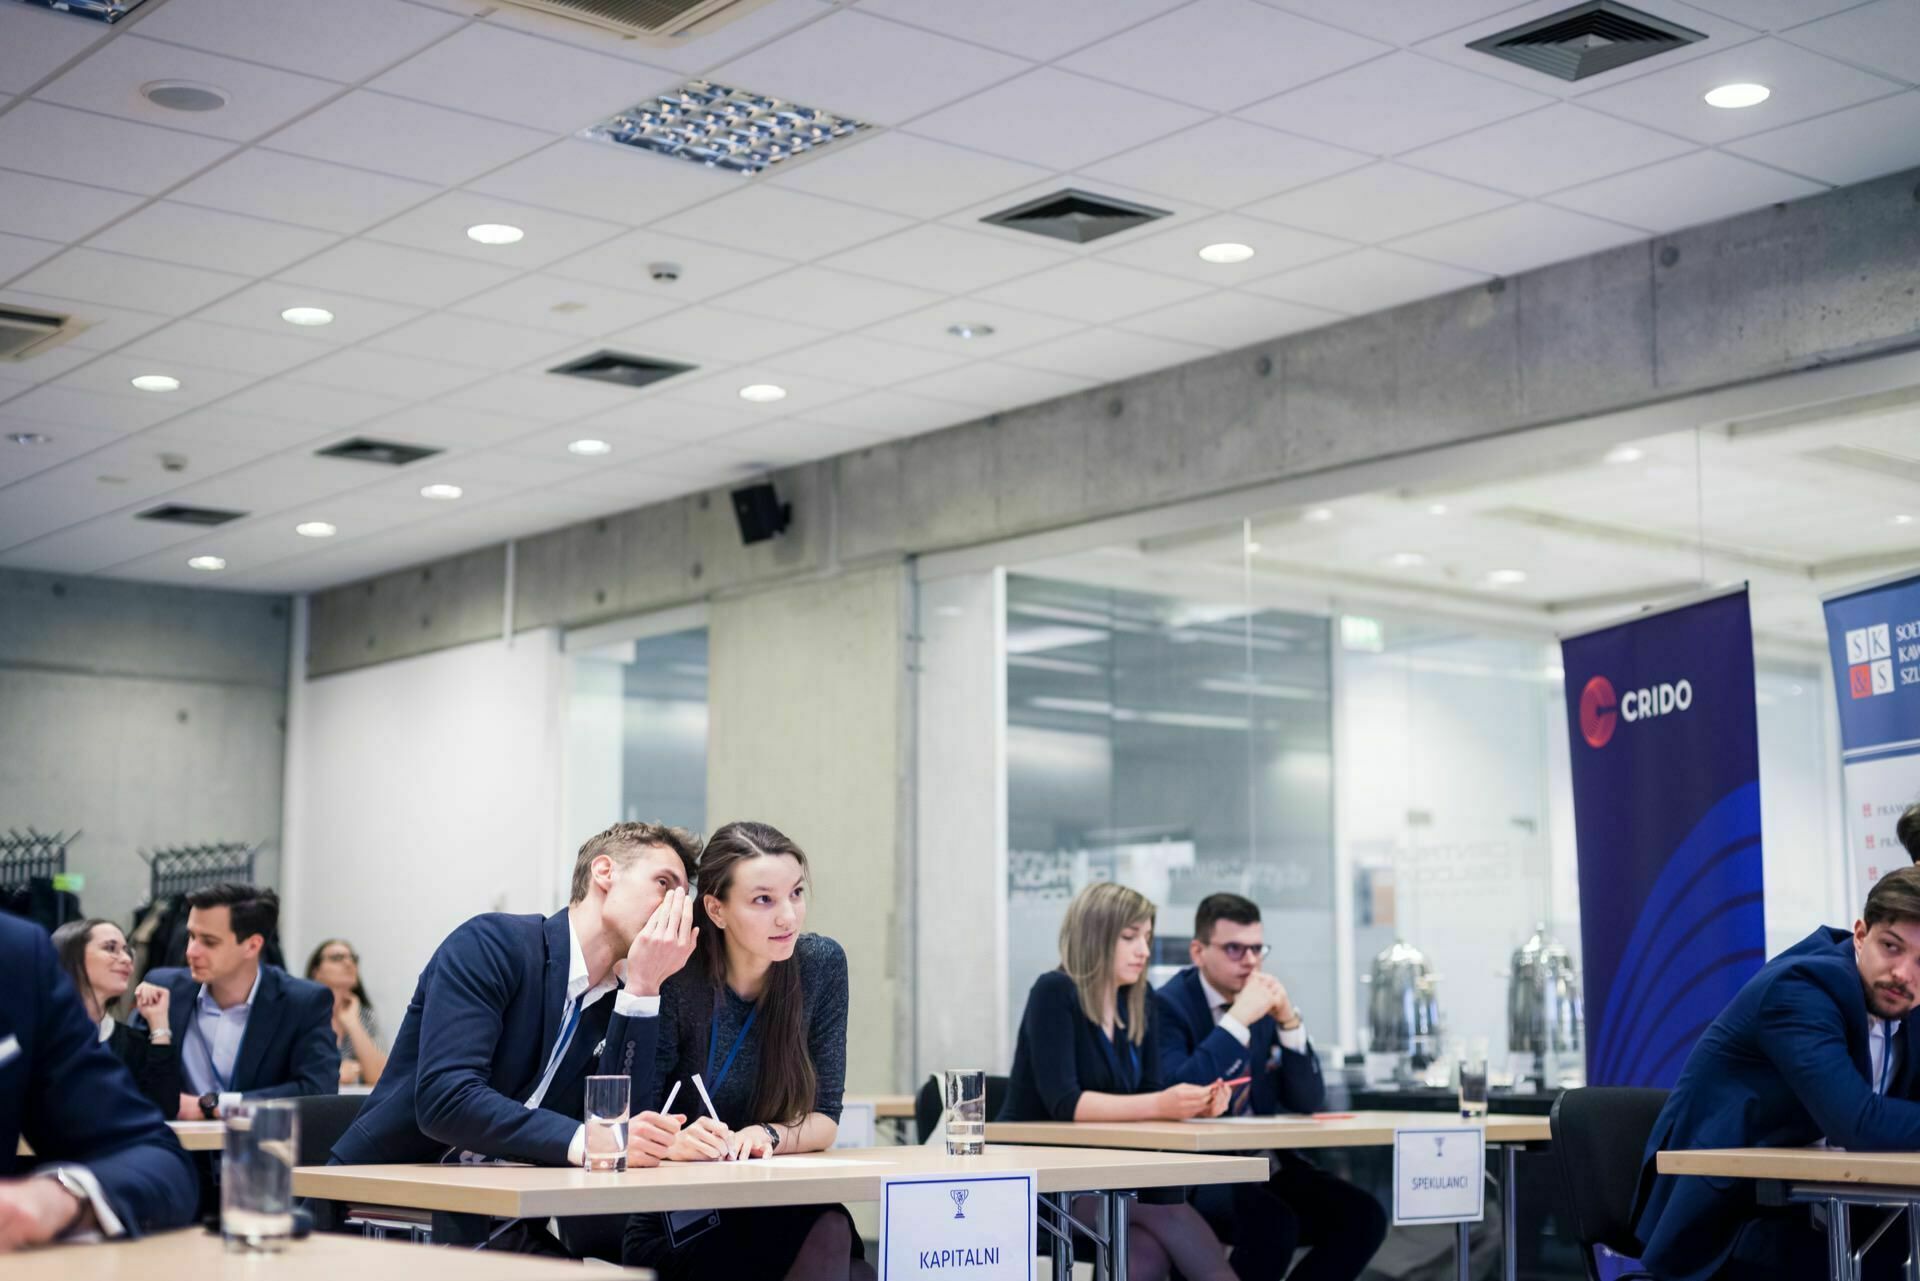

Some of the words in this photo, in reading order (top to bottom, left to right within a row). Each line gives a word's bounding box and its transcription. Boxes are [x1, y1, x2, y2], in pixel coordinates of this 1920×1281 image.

[1621, 678, 1693, 722] CRIDO
[1411, 1175, 1468, 1191] SPEKULANCI
[919, 1246, 1000, 1270] KAPITALNI
